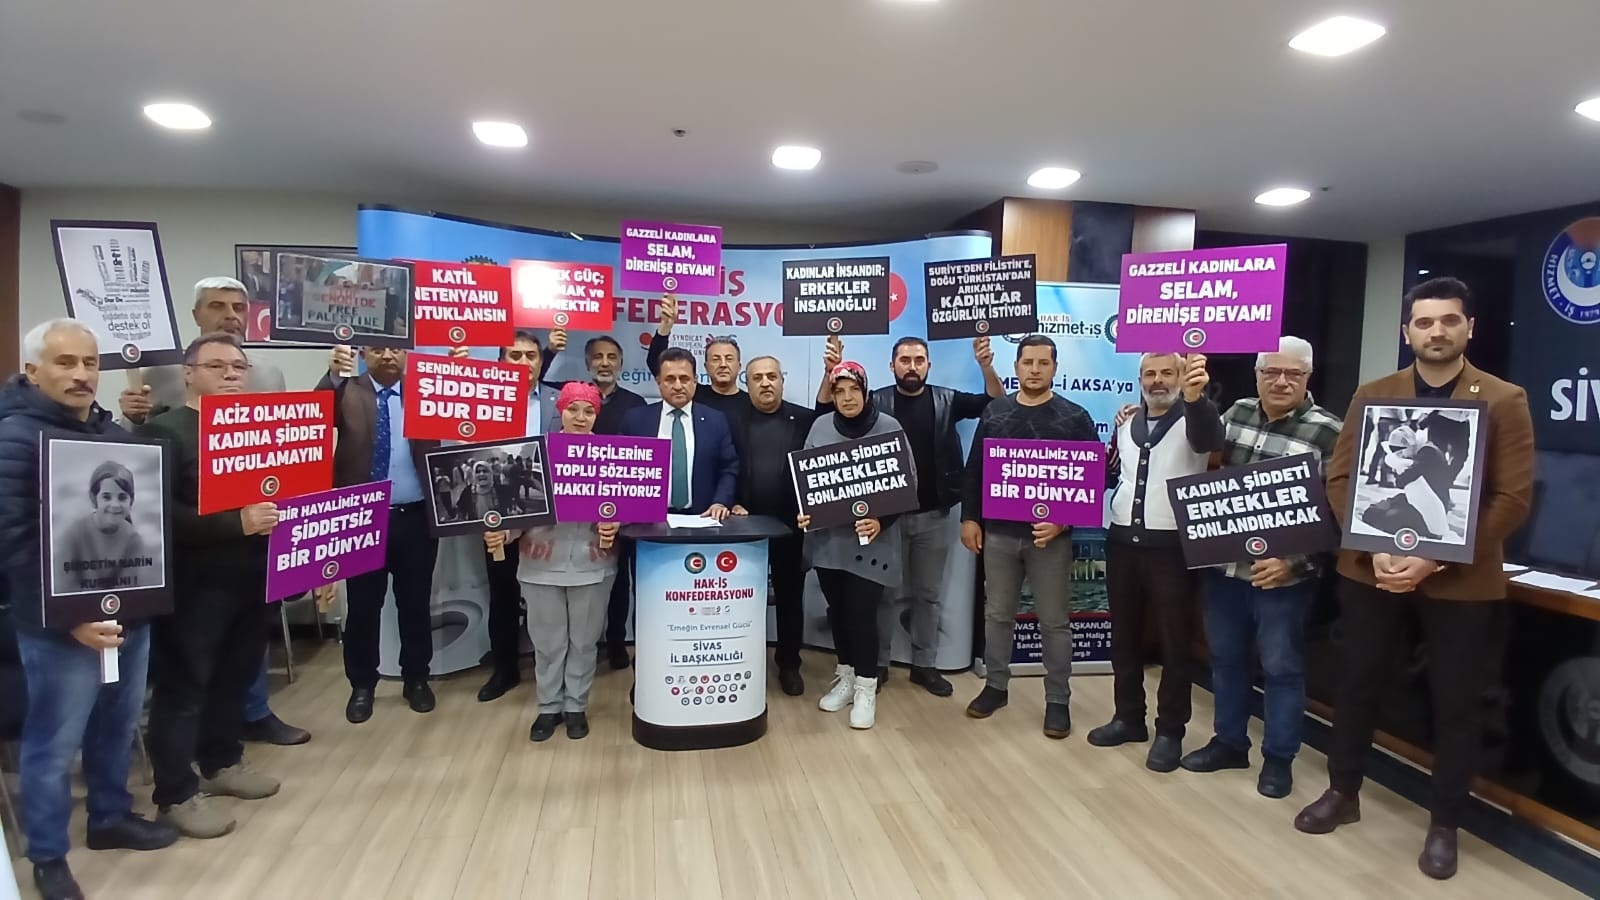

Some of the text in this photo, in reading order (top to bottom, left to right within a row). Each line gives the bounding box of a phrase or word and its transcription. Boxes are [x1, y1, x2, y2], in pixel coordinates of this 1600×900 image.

[626, 228, 716, 244] GAZZELİ KADINLARA
[647, 243, 695, 260] SELAM,
[626, 256, 715, 277] DİRENİŞE DEVAM!
[786, 263, 885, 280] KADINLAR İNSANDIR;
[1129, 257, 1276, 276] GAZZELİ KADINLARA
[432, 268, 477, 286] KATİL
[930, 276, 956, 287] DOĞU
[588, 288, 605, 298] ve
[800, 281, 870, 296] ERKEKLER
[1160, 280, 1238, 300] SELAM,
[794, 296, 877, 313] İNSANOĞLU!
[940, 291, 1021, 308] KADINLAR
[307, 310, 378, 327] PALESTINE
[415, 306, 507, 322] UTUKLANSIN
[932, 304, 1032, 323] ÖZGÜRLÜK İSTİYOR!
[1126, 303, 1272, 326] DİRENİŞE DEVAM!
[108, 320, 150, 331] destek ol
[417, 361, 520, 382] SENDİKAL GÜÇLE
[418, 375, 517, 402] ŞİDDETE
[1070, 378, 1133, 394] AKSA'ya
[212, 403, 324, 425] ACİZ OLMAYIN,
[420, 400, 513, 422] DUR DE!
[209, 423, 327, 451] KADINA ŞİDDET
[212, 446, 323, 475] UYGULAMAYIN
[567, 443, 653, 462] EV İŞÇİLERİNE
[799, 437, 901, 472] KADINA ŞİDDETİ
[989, 445, 1098, 461] BİR HAYALİMİZ VAR:
[554, 463, 663, 481] TOPLU SÖZLEŞME
[806, 457, 900, 489] ERKEKLER
[1001, 460, 1084, 481] ŞİDDETSİZ
[553, 481, 661, 498] HAKKI İSTİYORUZ
[806, 474, 908, 506] SONLANDIRACAK
[1176, 461, 1311, 501] KADINA ŞİDDETİ
[990, 480, 1095, 504] BİR DÜNYA!
[279, 491, 385, 522] BİR HAYALİMİZ VAR:
[1186, 485, 1309, 521] ERKEKLER
[291, 507, 373, 546] ŞİDDETSİZ
[1187, 506, 1321, 540] SONLANDIRACAK
[277, 530, 381, 571] BİR DÜNYA!
[665, 588, 754, 602] KONFEDERASYONU
[1070, 620, 1112, 630] AŞKANLIĞI
[693, 640, 722, 651] SİVAS
[670, 650, 743, 665] İL BAŞKANLIĞI
